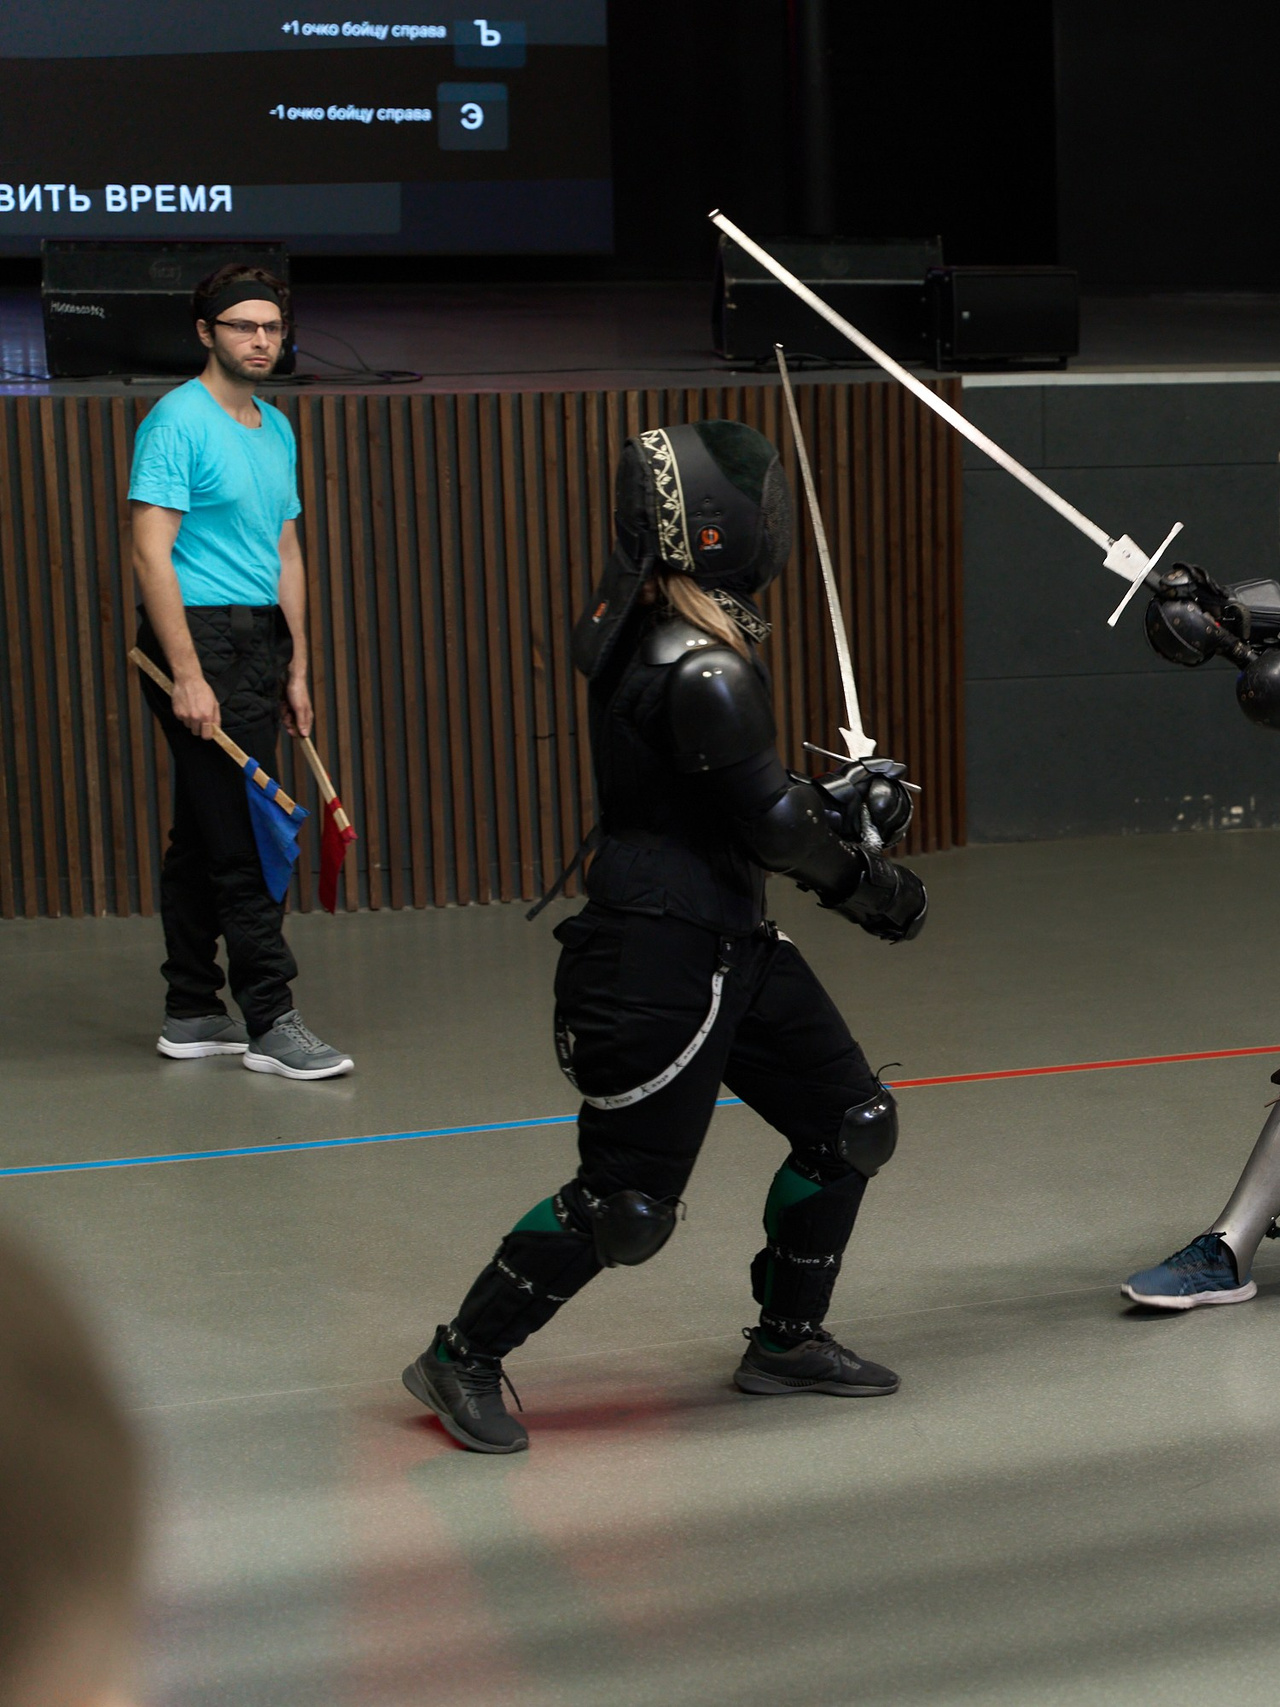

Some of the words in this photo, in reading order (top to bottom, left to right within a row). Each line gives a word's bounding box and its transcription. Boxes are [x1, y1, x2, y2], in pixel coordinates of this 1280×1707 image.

[281, 20, 300, 35] +1
[302, 23, 339, 36] очко
[342, 21, 388, 40] бойцу
[391, 24, 447, 40] справа
[473, 19, 502, 47] Ъ
[287, 107, 325, 121] очко
[327, 104, 374, 124] бойцу
[376, 107, 432, 124] справа
[460, 102, 484, 130] Э
[105, 184, 232, 213] ВРЕМЯ
